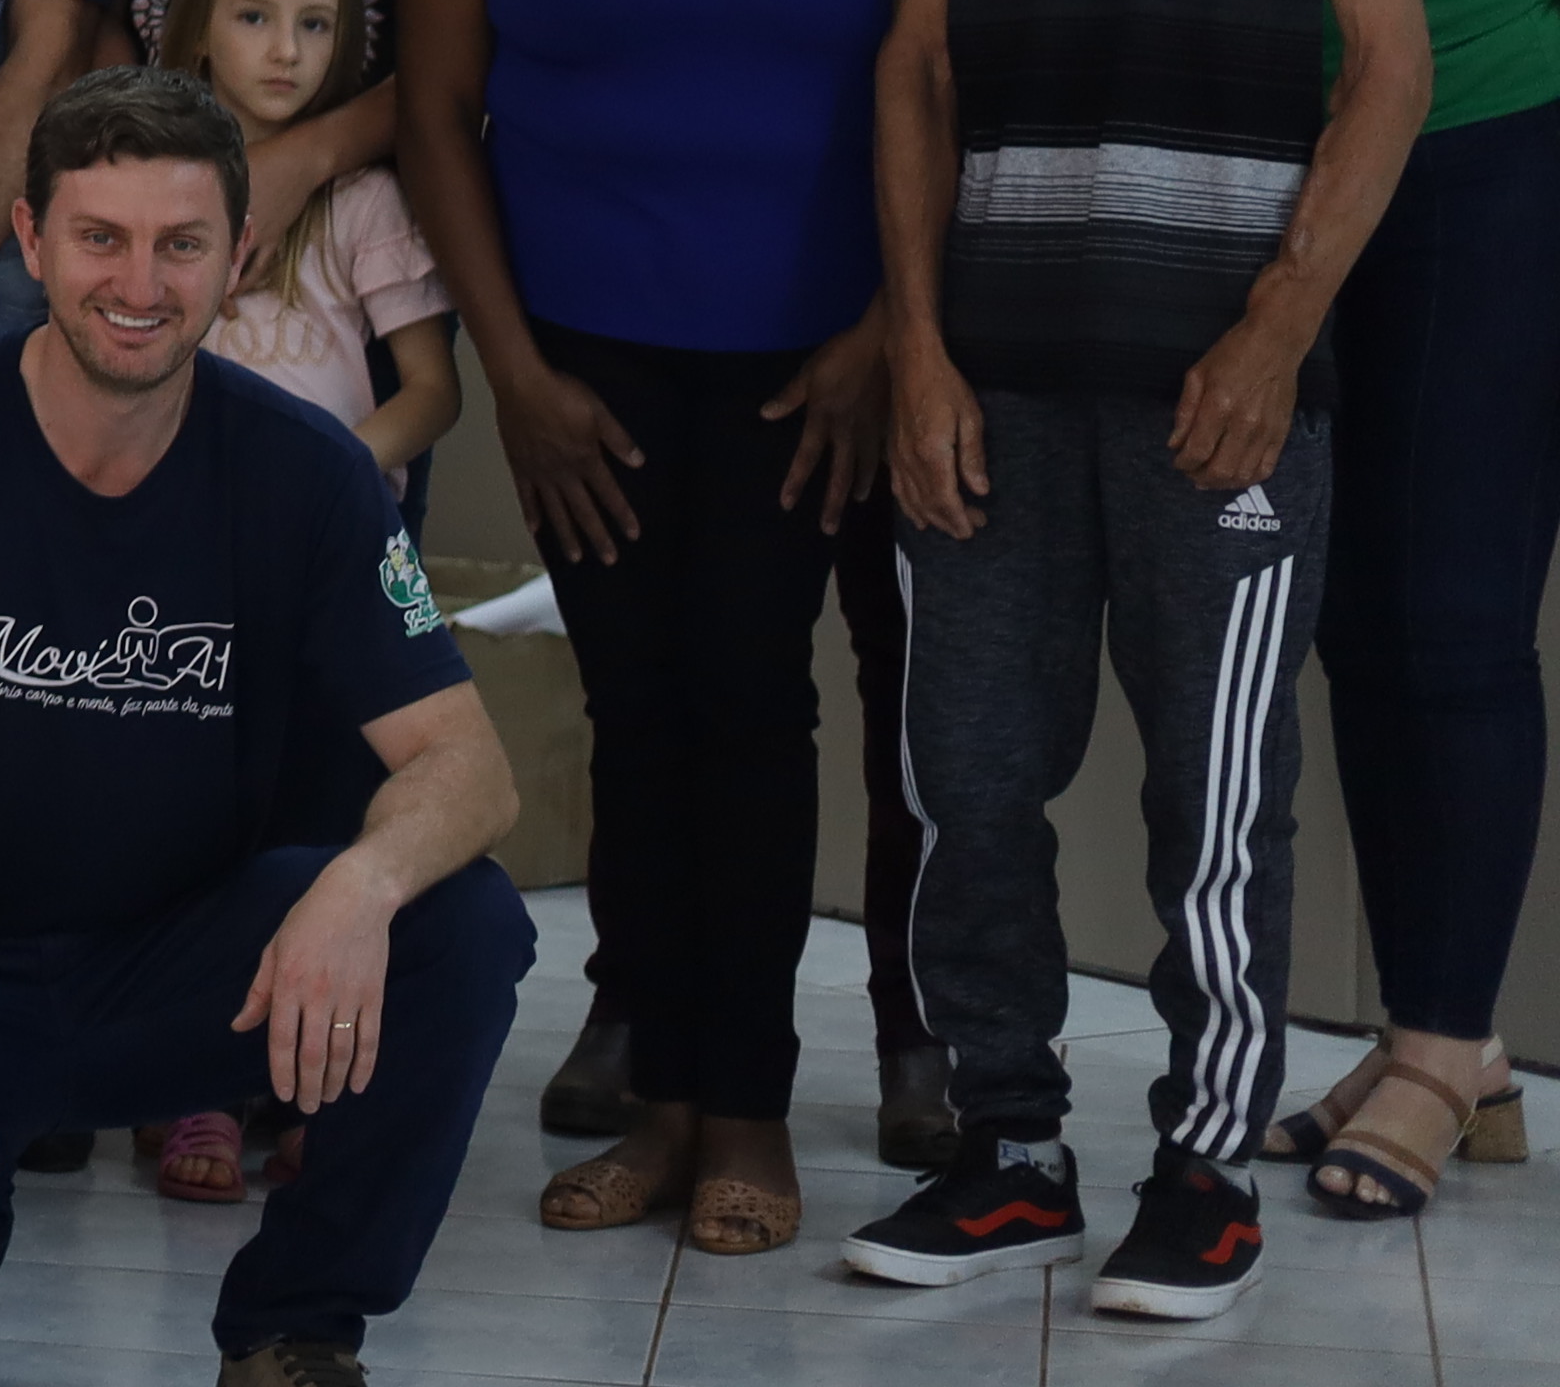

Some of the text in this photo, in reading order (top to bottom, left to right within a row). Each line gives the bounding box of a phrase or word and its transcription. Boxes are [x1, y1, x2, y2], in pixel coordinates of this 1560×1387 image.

[1217, 512, 1281, 531] adidas
[167, 635, 231, 691] A1
[25, 688, 64, 709] corpo
[66, 696, 76, 708] e
[77, 695, 117, 714] mente,
[120, 696, 142, 717] faz
[141, 696, 179, 717] parte
[181, 695, 199, 714] da
[198, 701, 234, 721] gente
